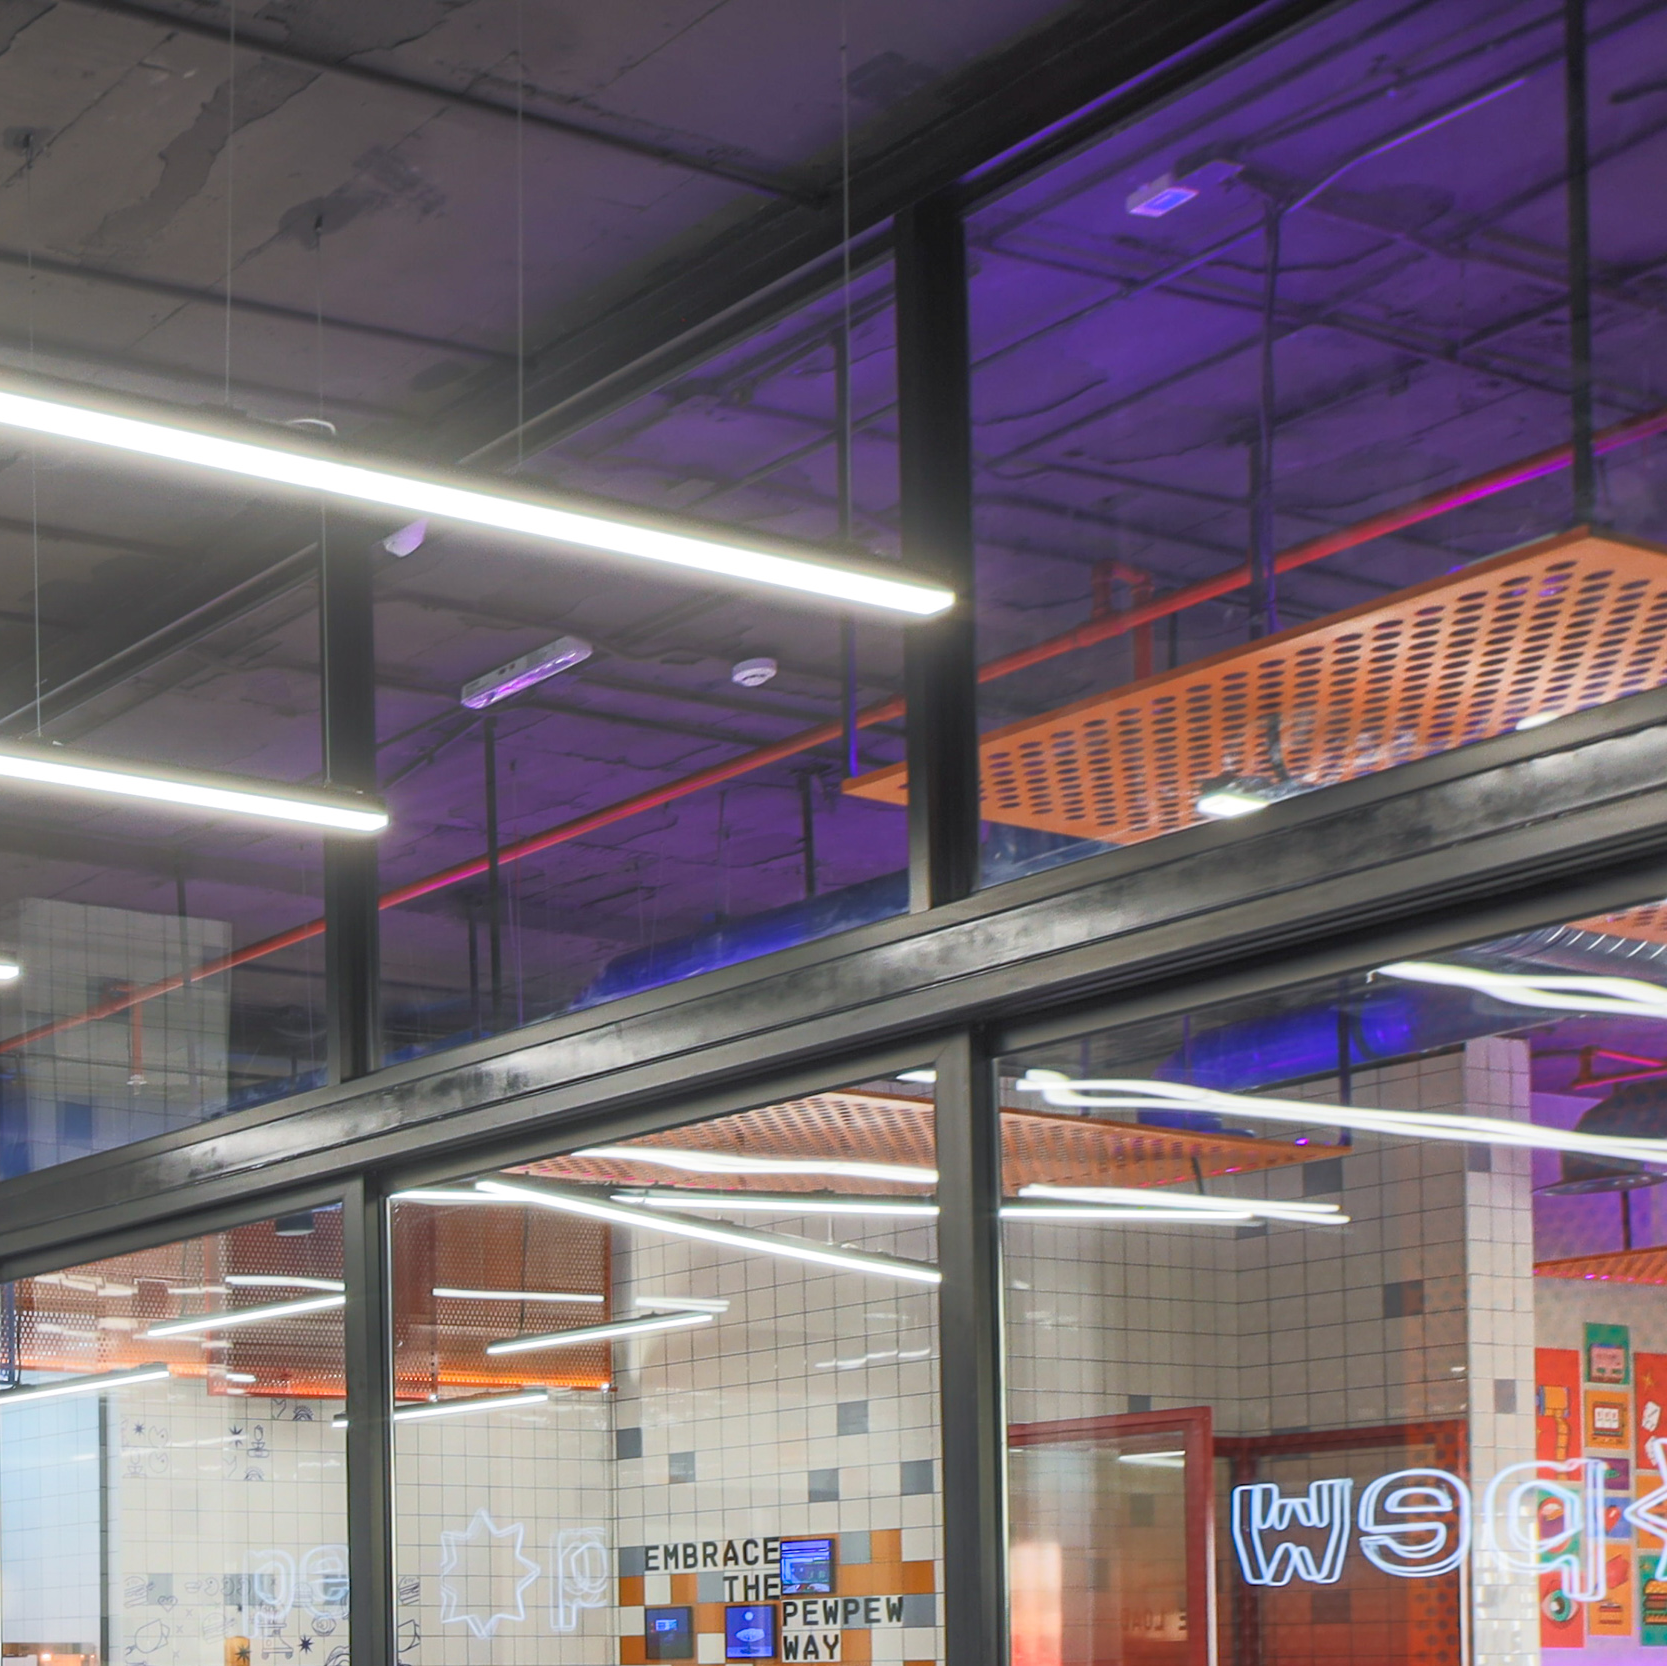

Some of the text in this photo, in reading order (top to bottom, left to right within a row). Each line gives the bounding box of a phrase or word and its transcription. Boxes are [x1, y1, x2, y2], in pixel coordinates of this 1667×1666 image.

[644, 1537, 780, 1572] EMBRACE
[723, 1573, 780, 1602] THE
[782, 1596, 904, 1628] PEWPEW
[782, 1633, 840, 1662] WAY
